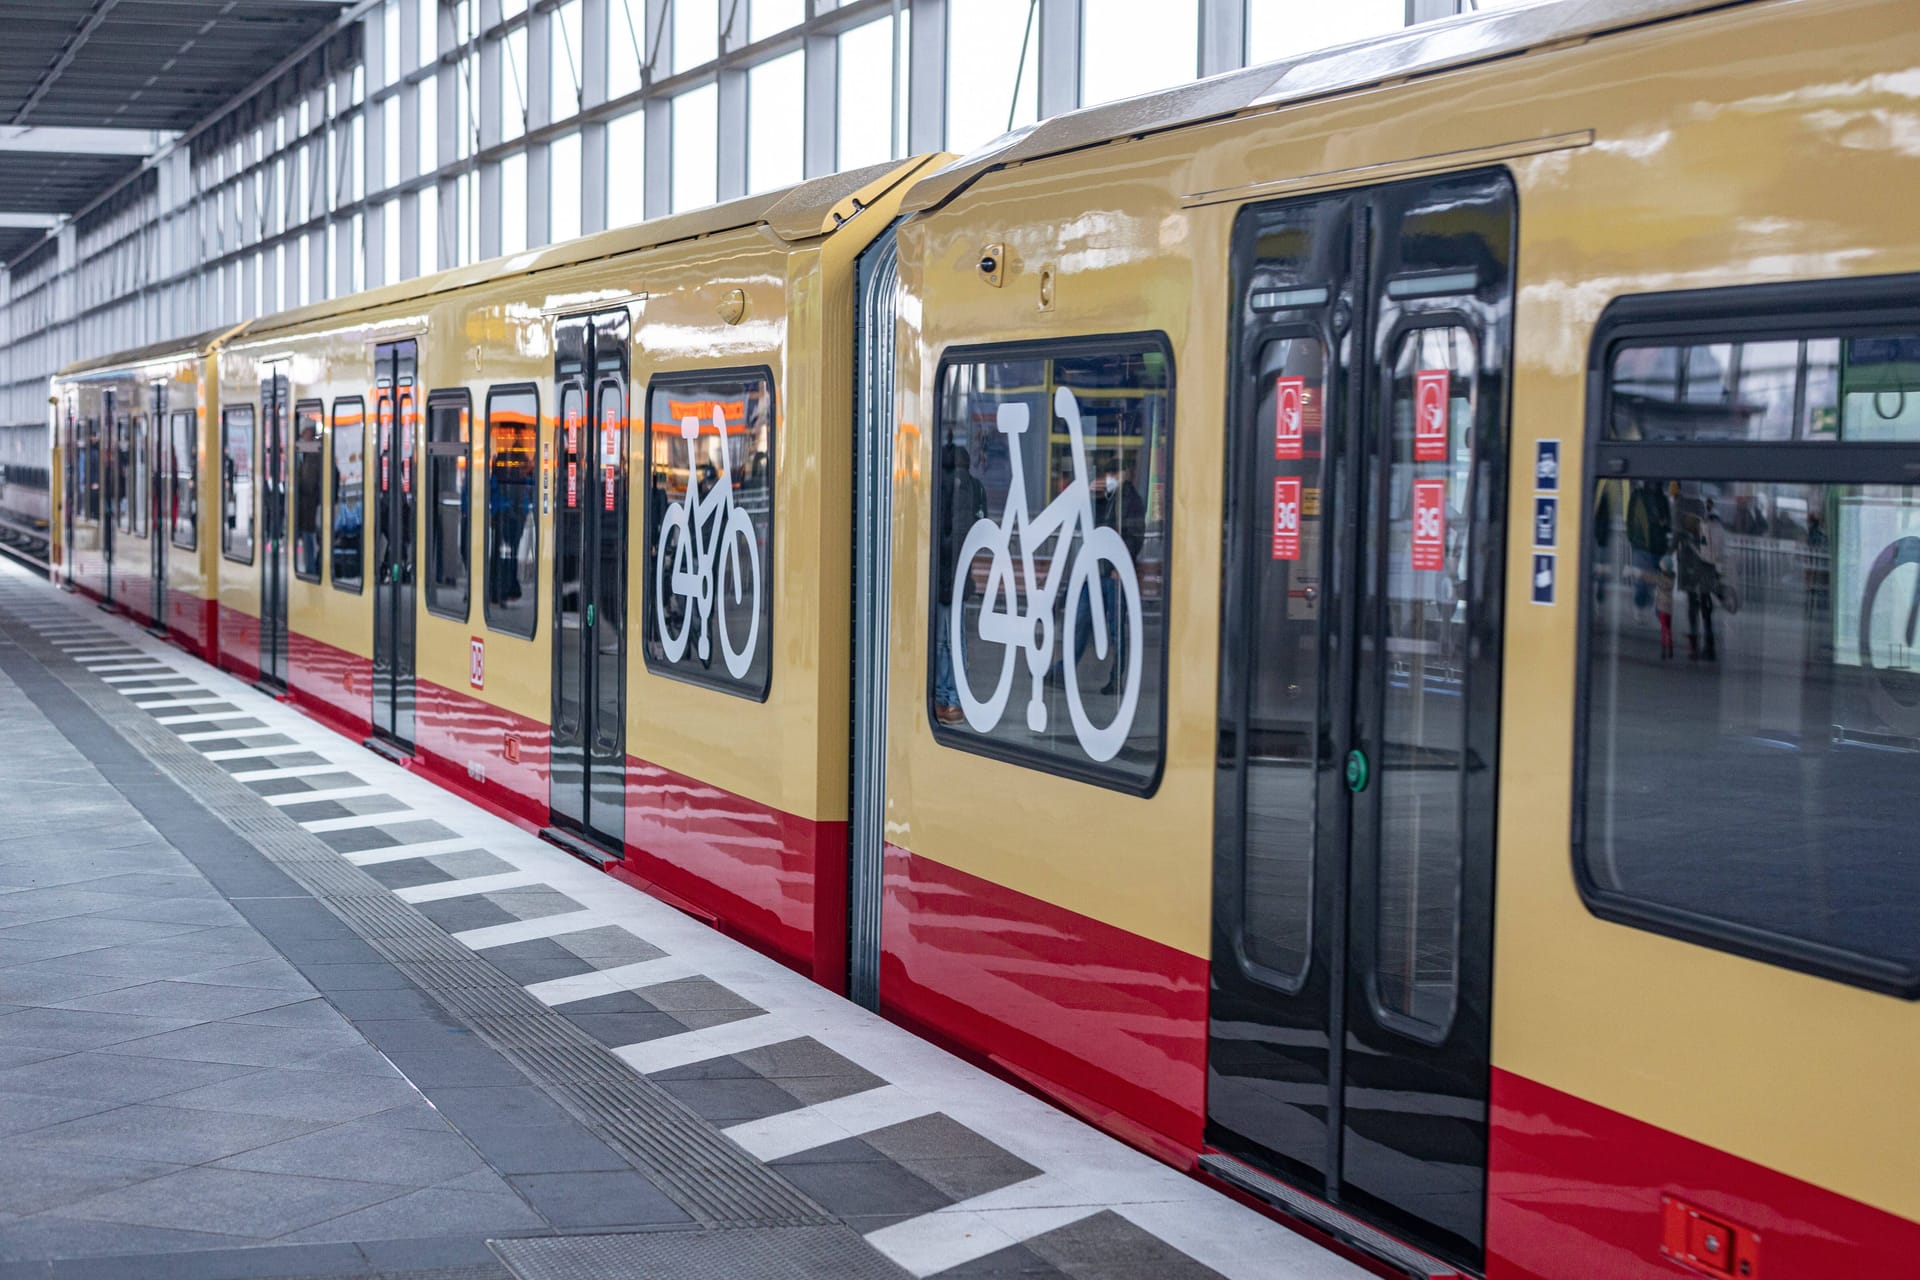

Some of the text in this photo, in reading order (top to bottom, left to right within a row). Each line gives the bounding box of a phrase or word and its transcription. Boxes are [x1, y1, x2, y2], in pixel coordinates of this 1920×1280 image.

[1277, 502, 1297, 529] 3G
[1416, 507, 1440, 537] 3G
[472, 645, 483, 681] DB
